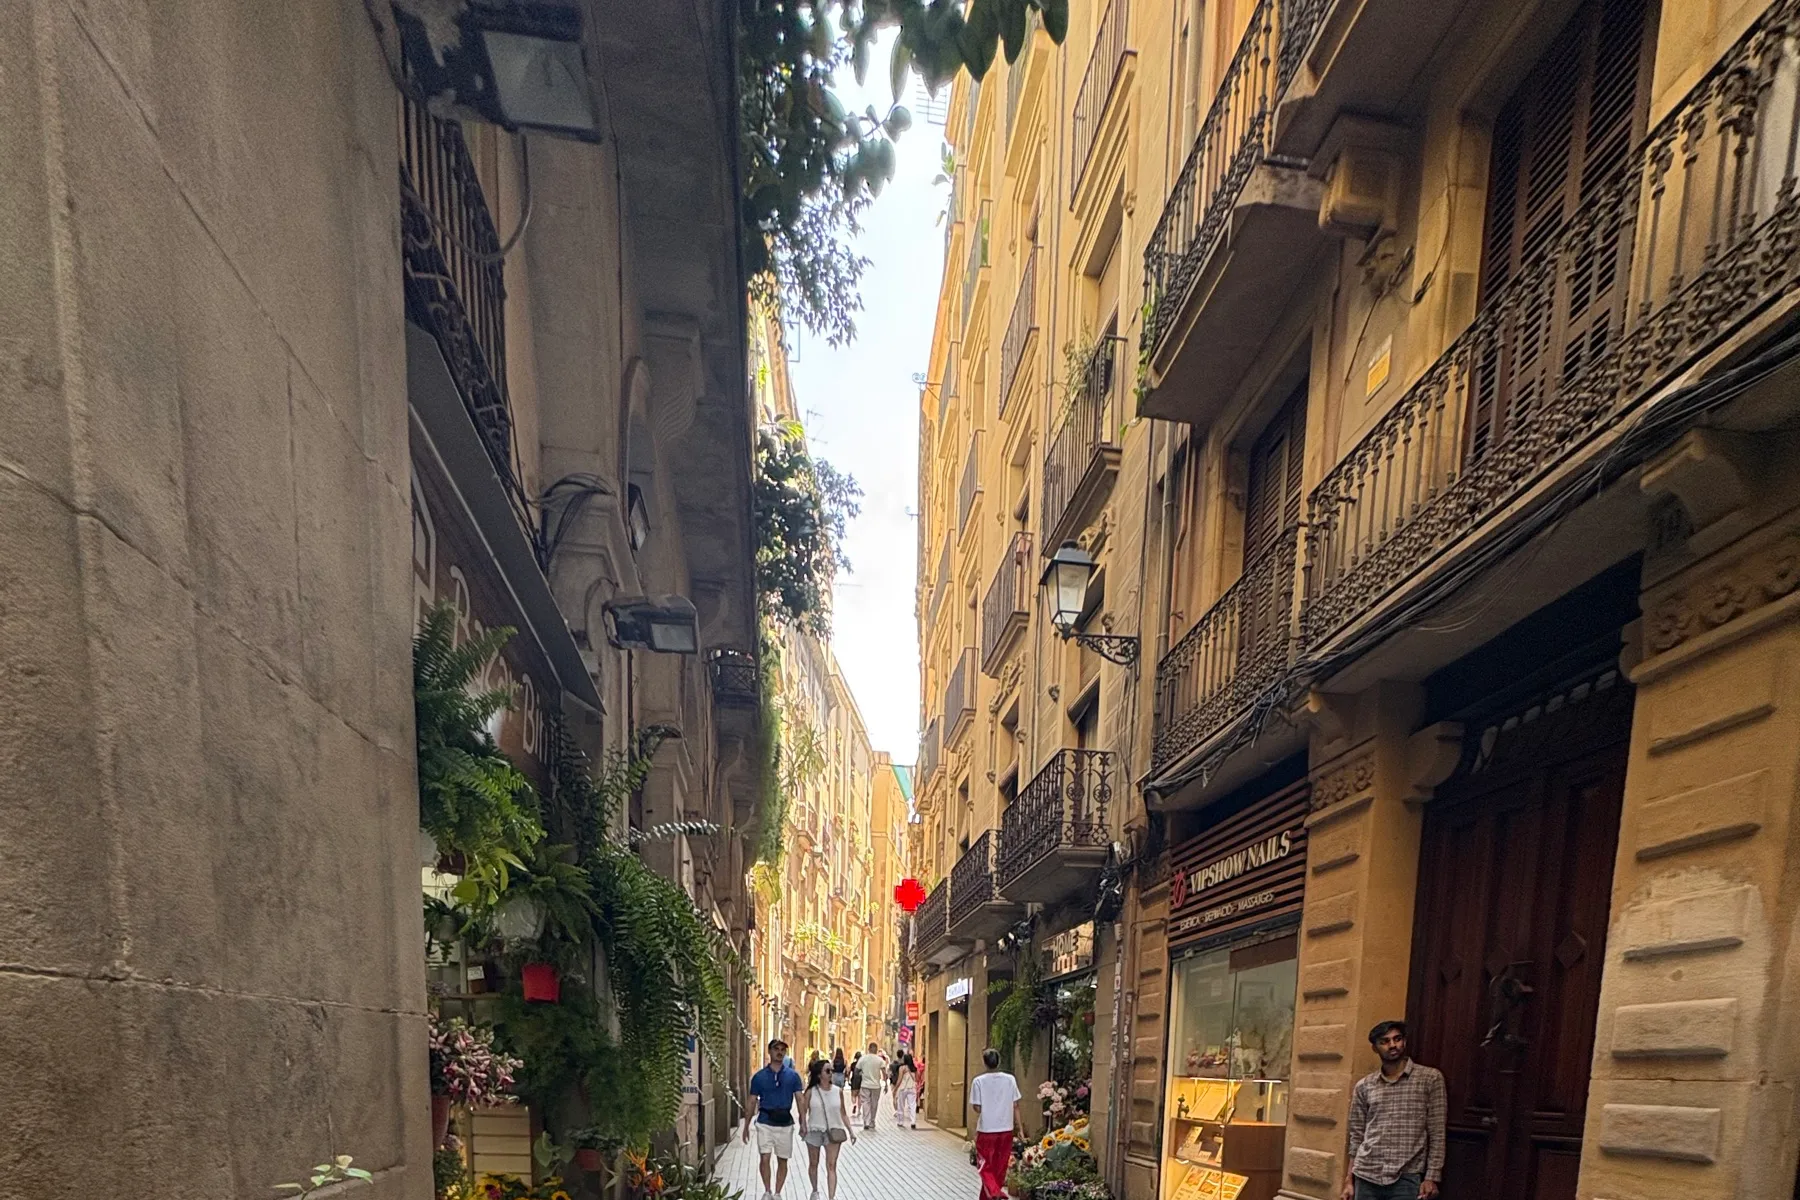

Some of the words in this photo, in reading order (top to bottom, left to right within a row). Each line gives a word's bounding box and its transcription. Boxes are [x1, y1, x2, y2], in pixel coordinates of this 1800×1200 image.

[1190, 851, 1246, 893] VIPSHOW
[1247, 831, 1291, 869] NAILS
[1052, 931, 1078, 959] HOME
